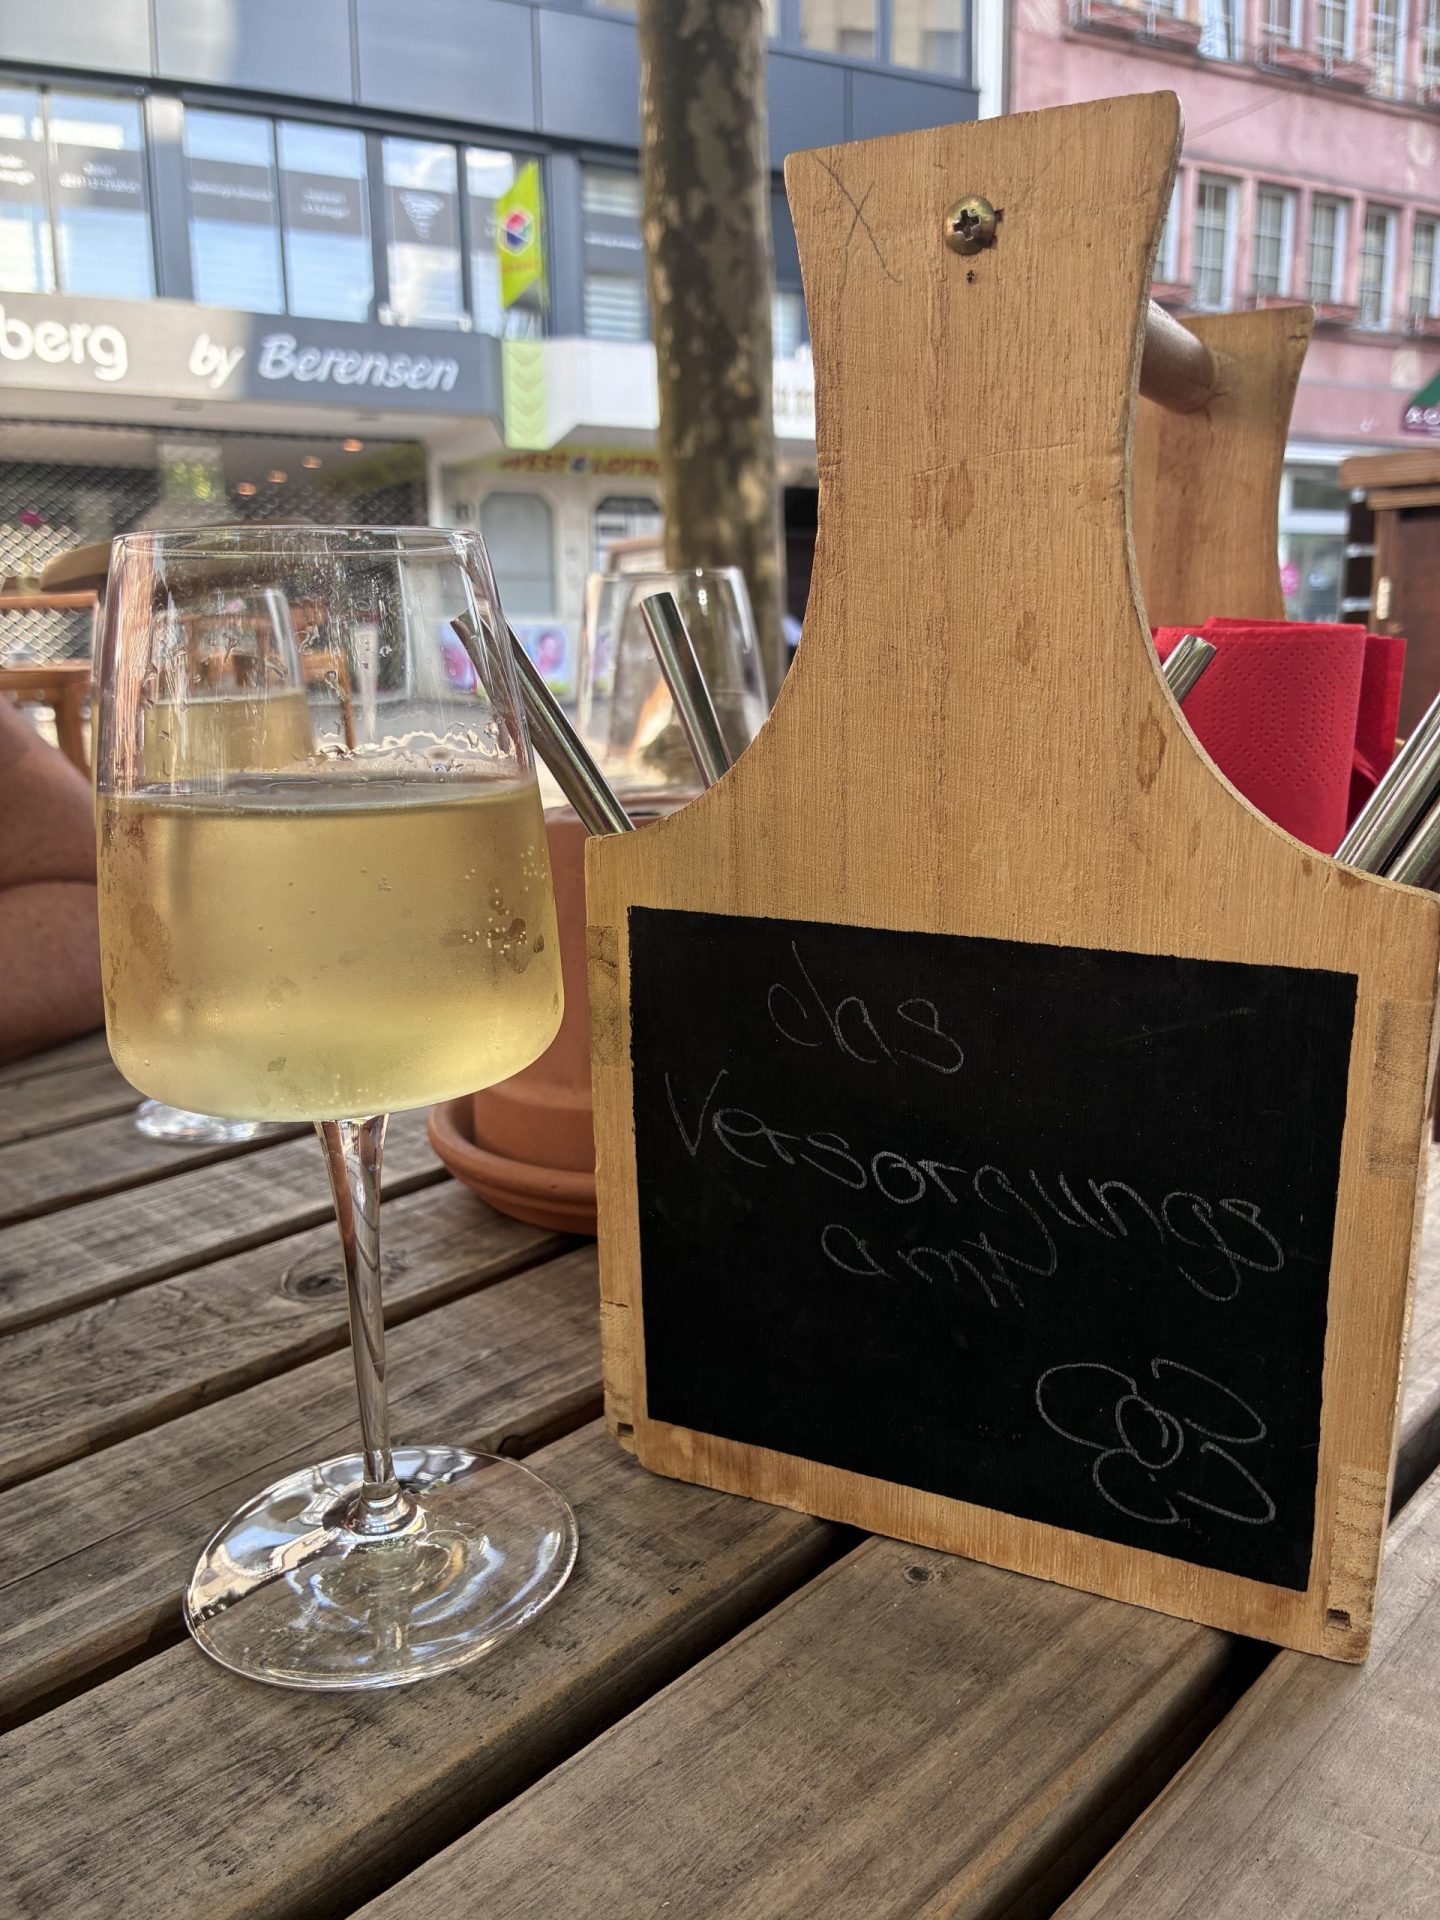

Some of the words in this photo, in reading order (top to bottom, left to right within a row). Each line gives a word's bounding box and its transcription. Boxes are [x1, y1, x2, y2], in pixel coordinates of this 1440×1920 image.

[189, 333, 246, 389] by
[258, 333, 460, 392] Berensen
[767, 940, 964, 1075] das
[821, 1224, 1025, 1308] amt
